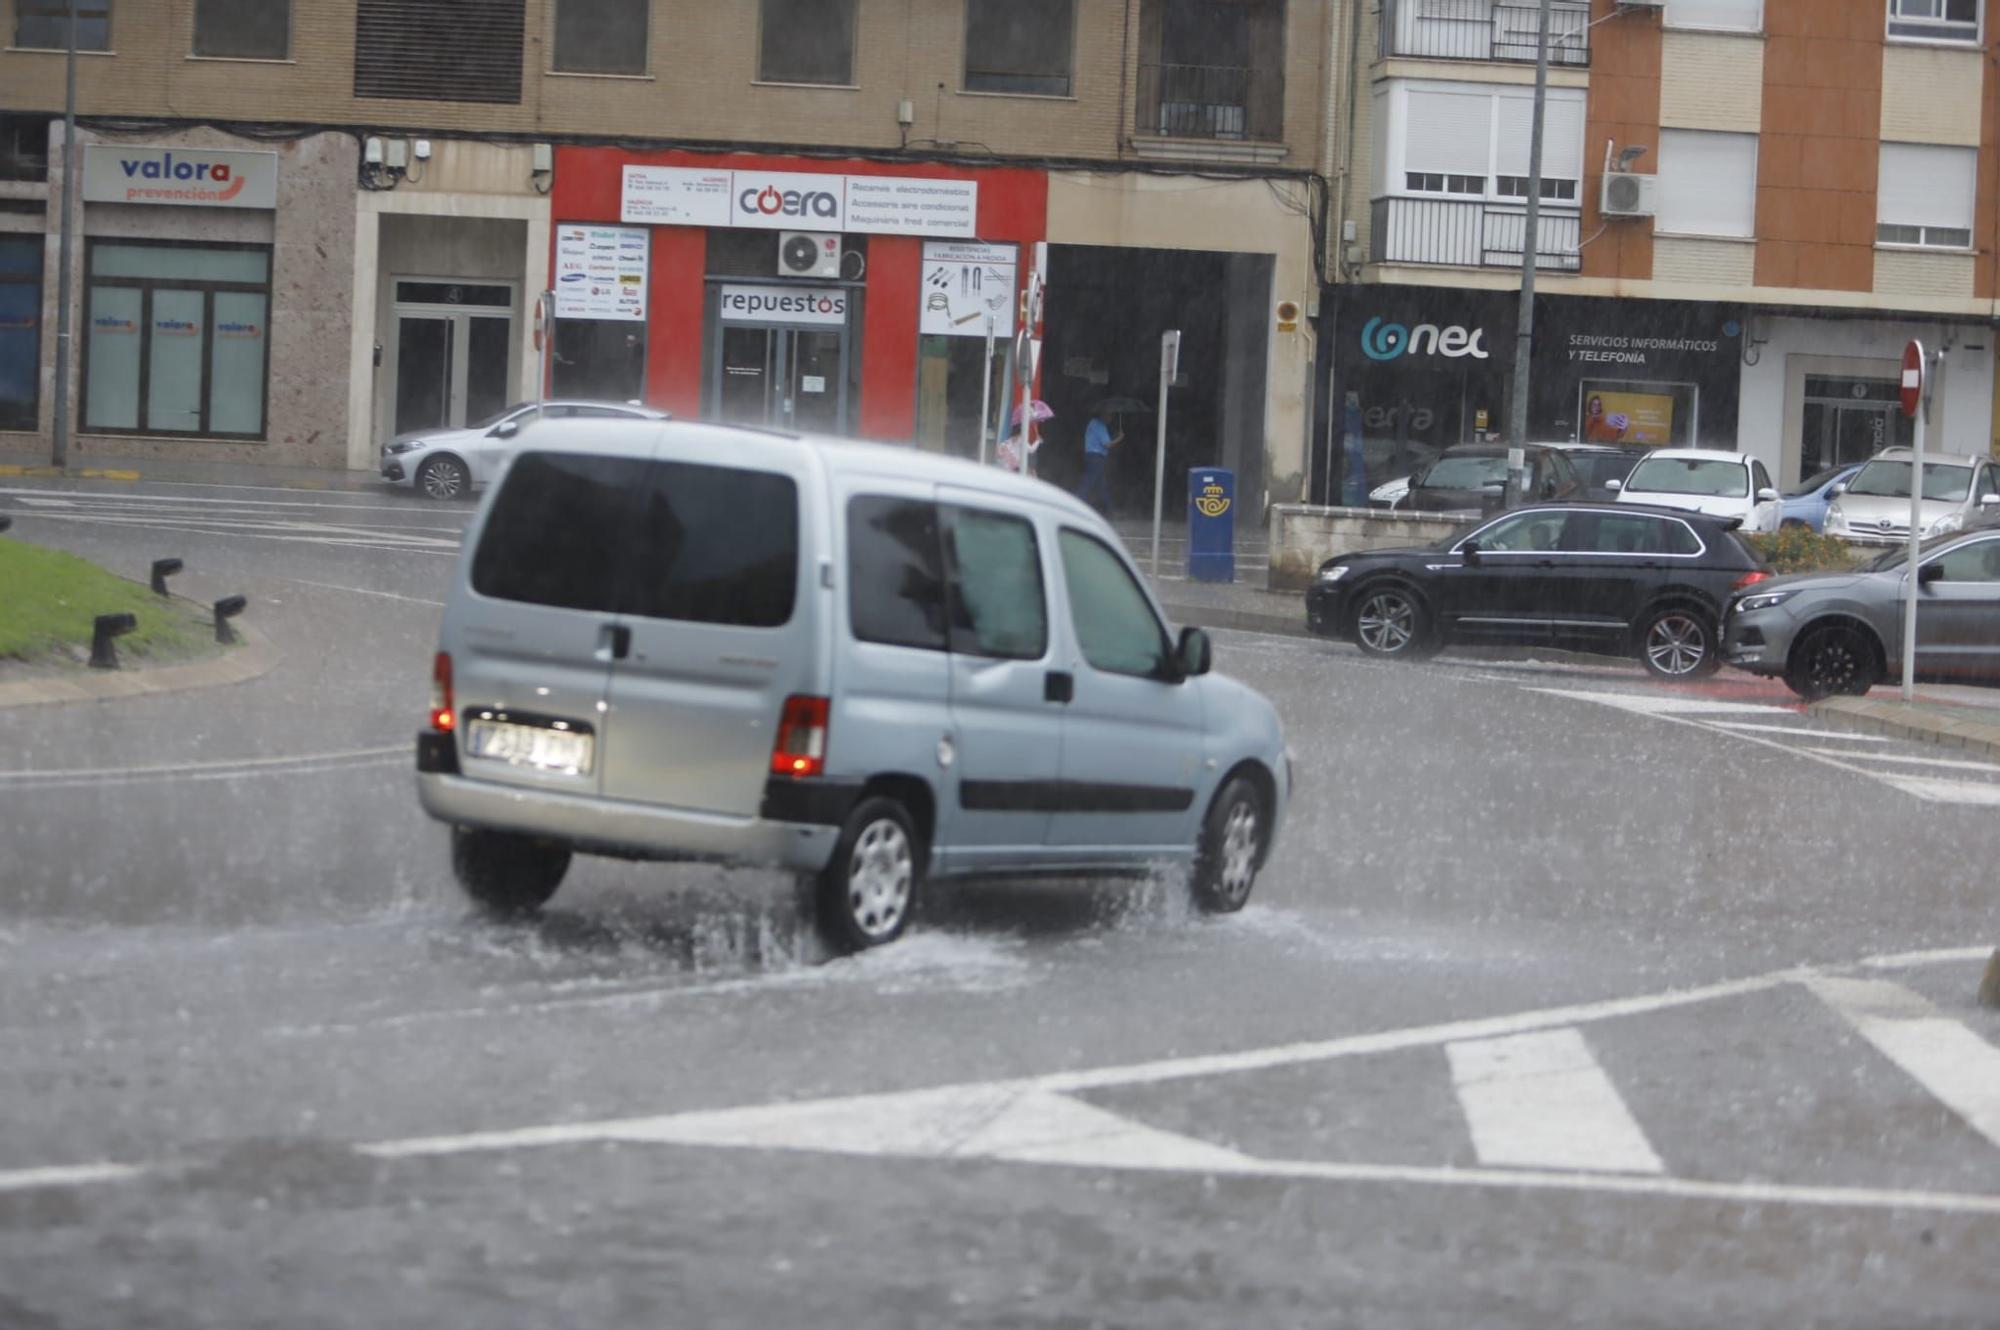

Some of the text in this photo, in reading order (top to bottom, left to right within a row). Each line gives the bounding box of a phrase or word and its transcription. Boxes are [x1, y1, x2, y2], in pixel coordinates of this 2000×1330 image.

[120, 153, 230, 182] valora
[126, 186, 218, 200] prevención
[722, 294, 845, 315] repuestos
[1569, 334, 1718, 352] SERVICIOS INFORMÁTICOS
[1568, 350, 1645, 363] Y TELEFONÍA
